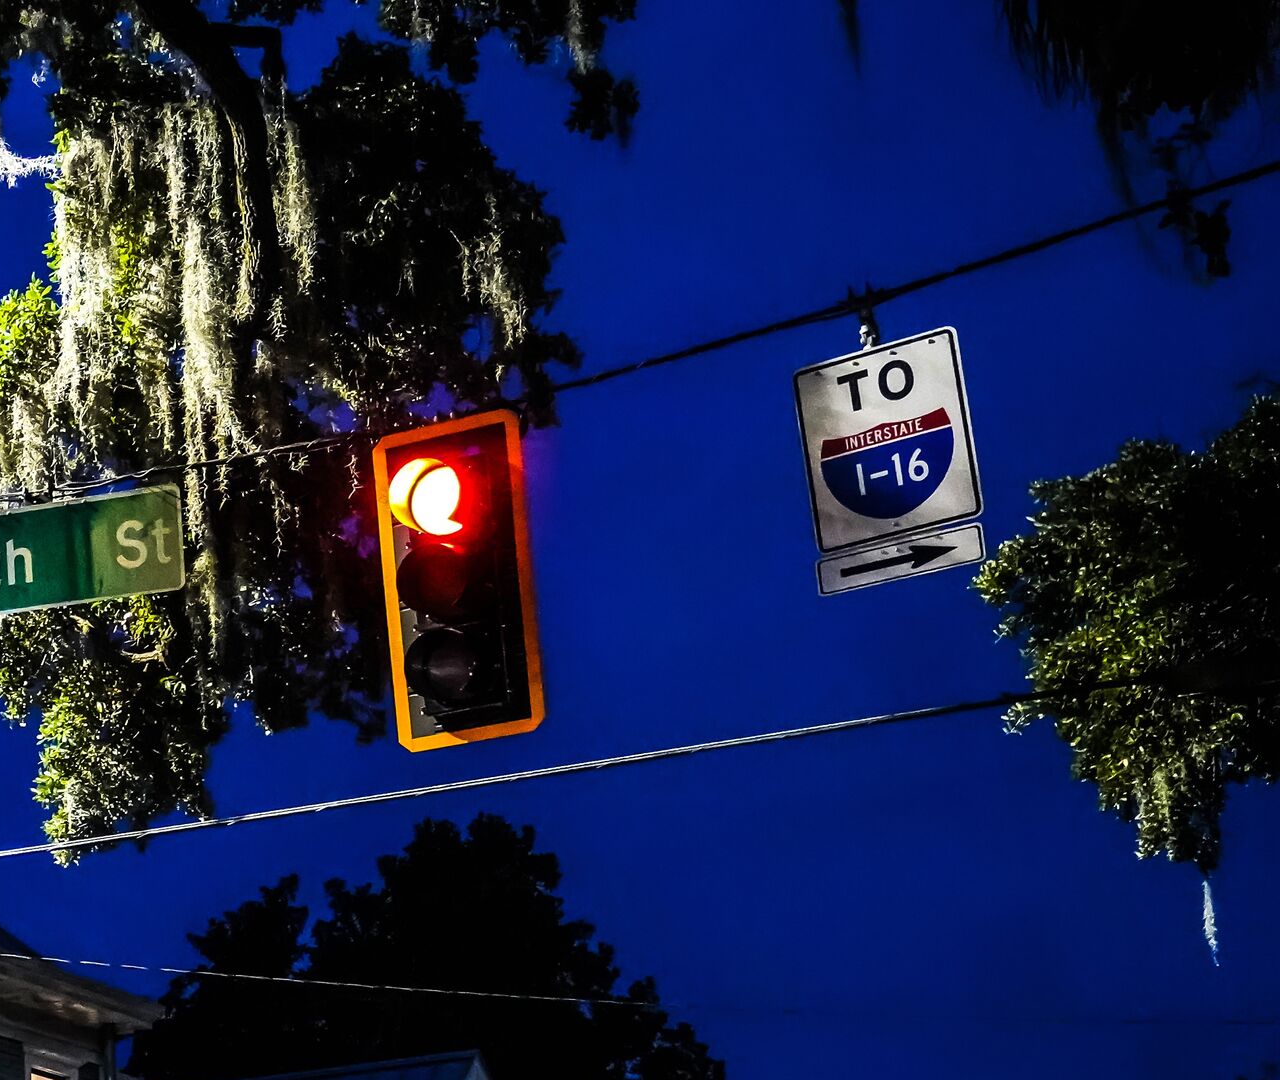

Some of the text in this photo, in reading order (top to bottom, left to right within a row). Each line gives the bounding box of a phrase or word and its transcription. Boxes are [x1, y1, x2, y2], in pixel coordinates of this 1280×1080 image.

[837, 359, 914, 412] TO
[845, 417, 924, 451] INTERSTATE
[856, 448, 929, 496] I-16
[116, 518, 172, 569] St
